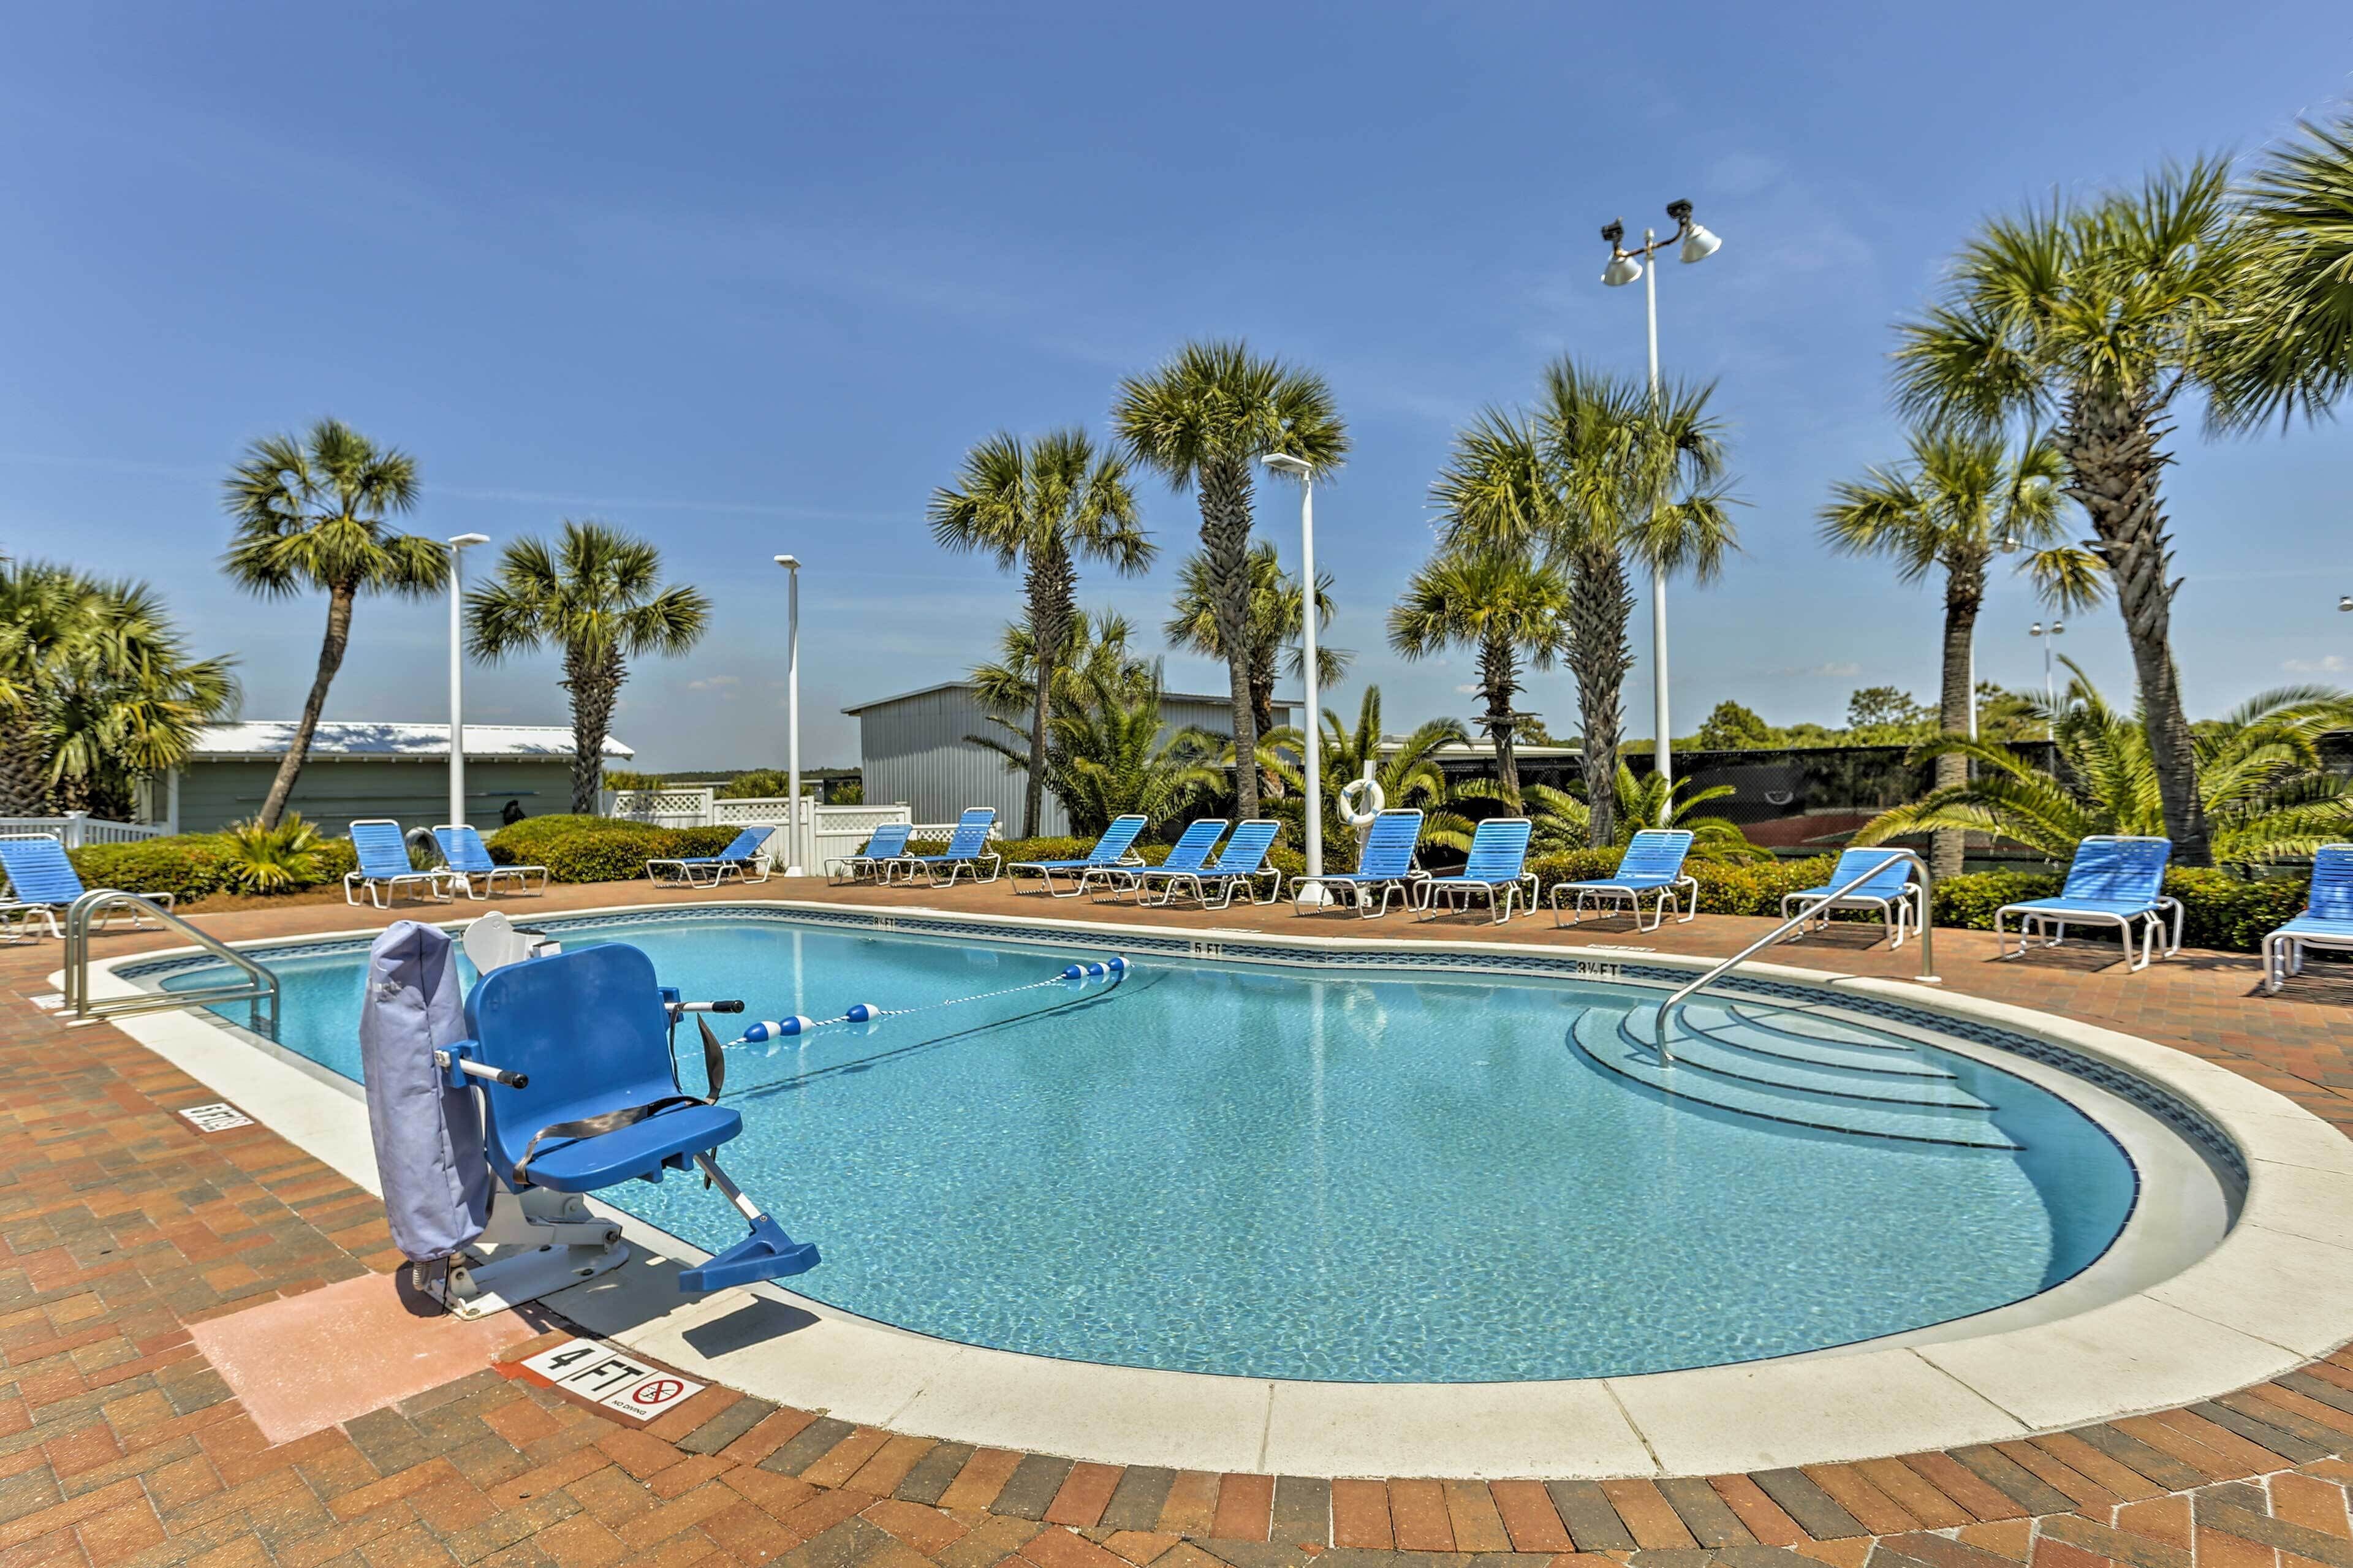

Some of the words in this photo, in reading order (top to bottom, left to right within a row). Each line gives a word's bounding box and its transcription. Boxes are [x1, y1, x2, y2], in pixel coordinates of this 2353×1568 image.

[1195, 942, 1201, 953] 5
[1207, 943, 1220, 954] FT
[1601, 963, 1618, 975] FT
[548, 1347, 596, 1370] 4
[570, 1360, 646, 1392] FT
[623, 1404, 647, 1415] DIVING
